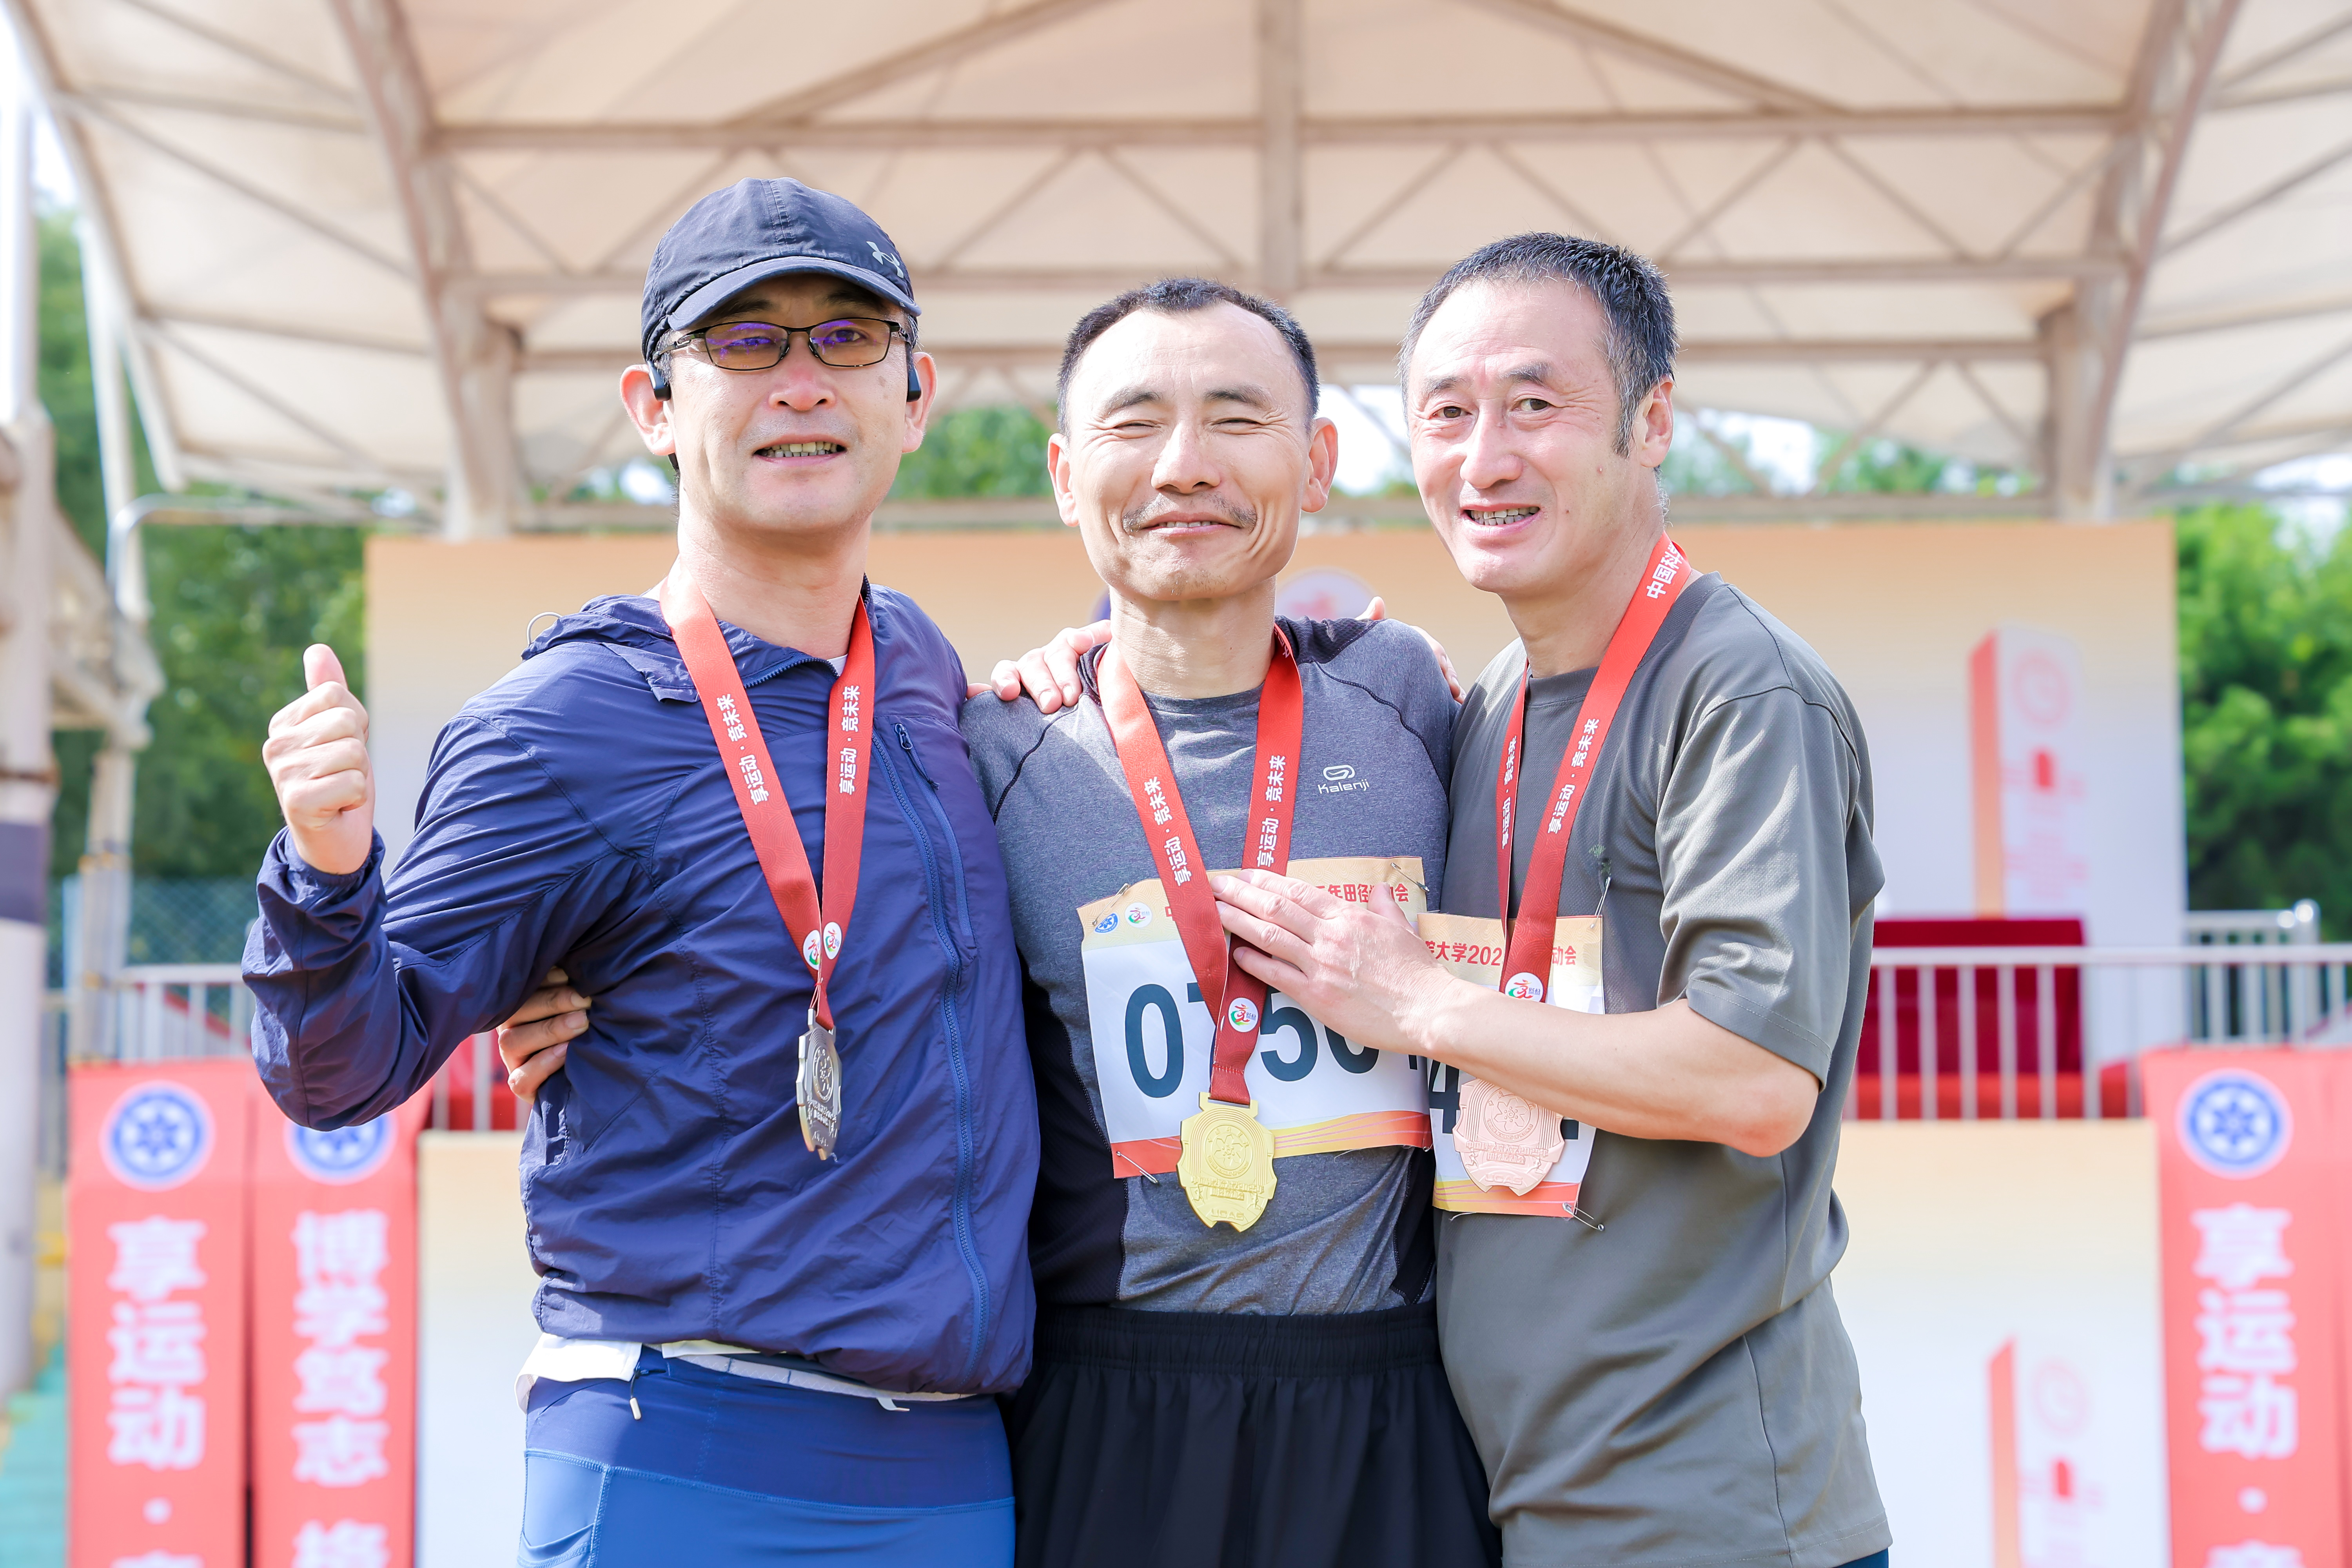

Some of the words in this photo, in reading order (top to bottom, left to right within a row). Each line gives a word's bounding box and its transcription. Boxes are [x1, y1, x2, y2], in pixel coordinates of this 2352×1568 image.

[716, 693, 769, 806] 享运动·竞未来
[838, 685, 860, 795] 享运动·竞未来
[1318, 779, 1370, 794] Kalenji
[1547, 718, 1600, 835] 享运动·竞未来
[1143, 776, 1192, 887] 享运动·竞未来
[1256, 755, 1286, 867] 享运动·竞未来
[107, 1216, 207, 1568] 享运动·
